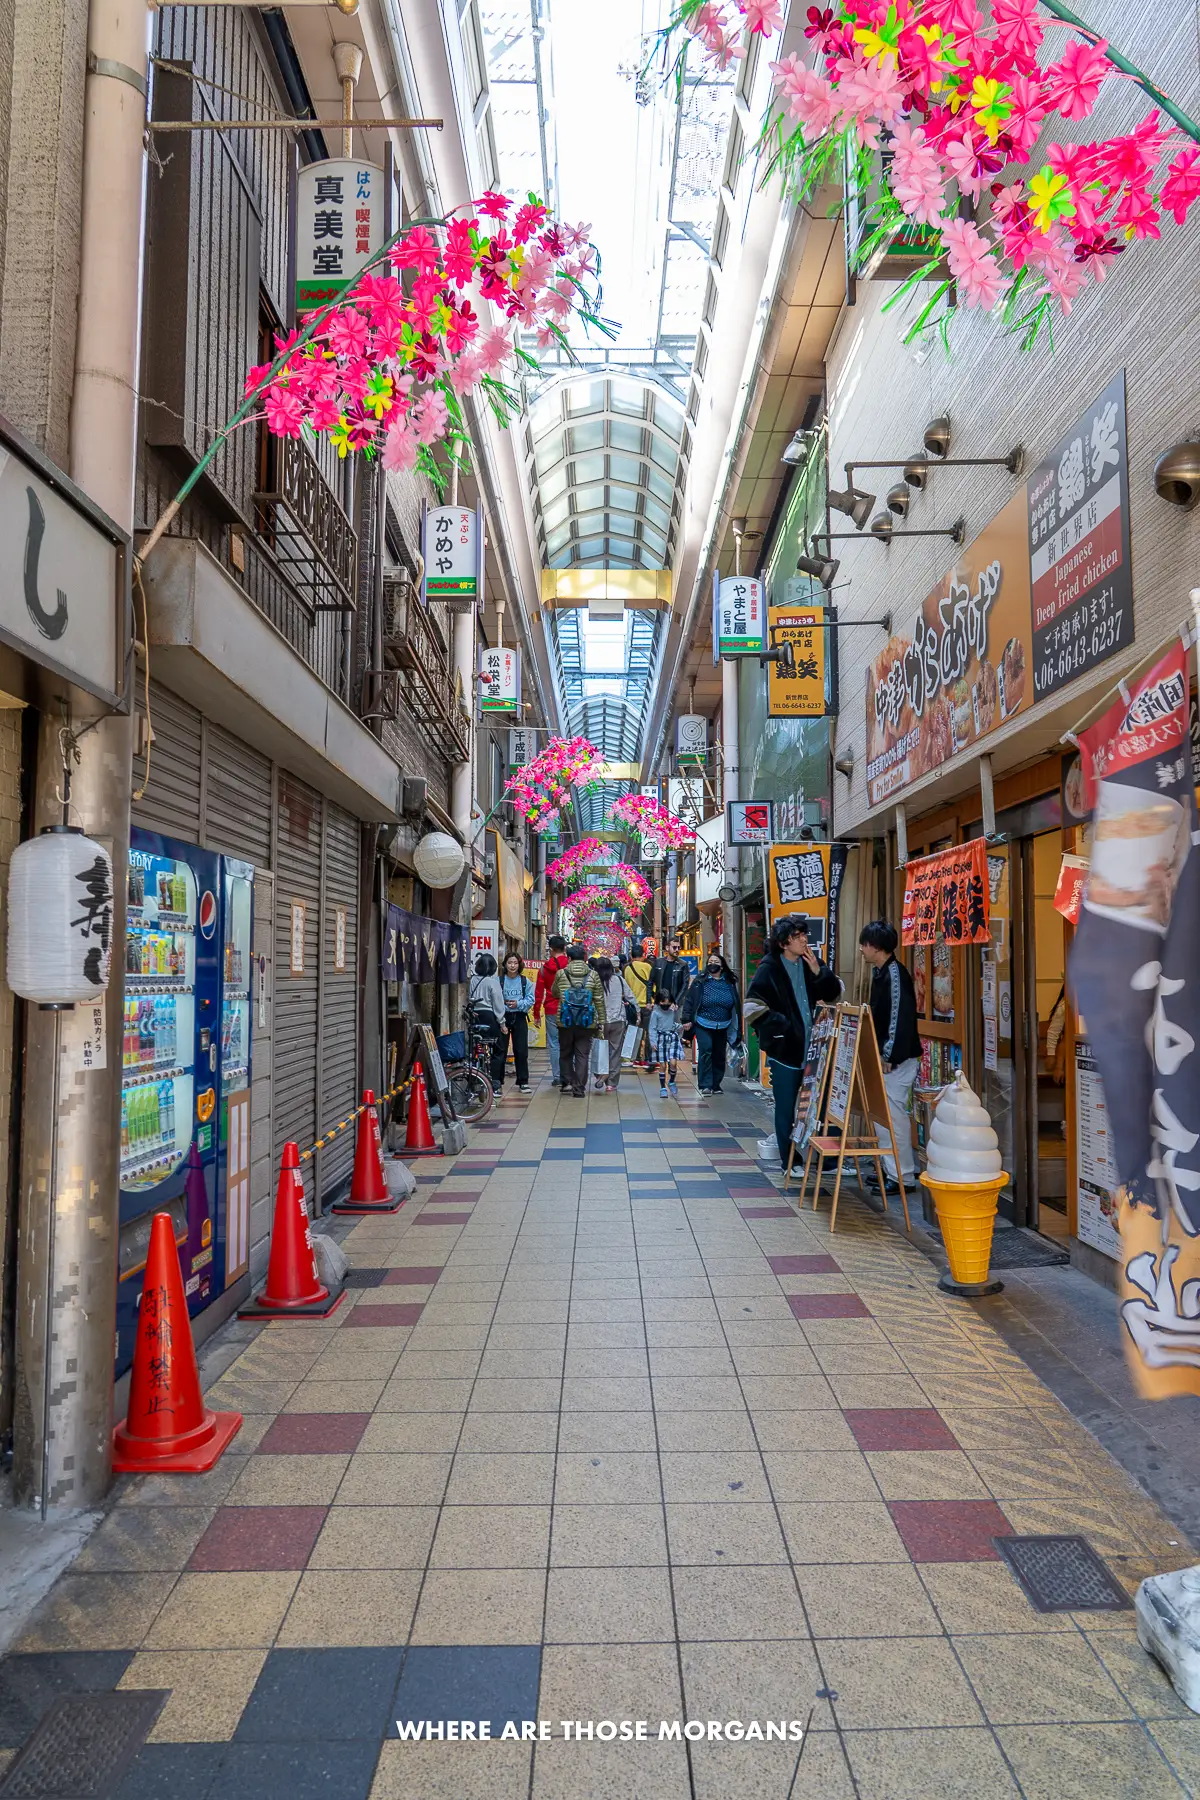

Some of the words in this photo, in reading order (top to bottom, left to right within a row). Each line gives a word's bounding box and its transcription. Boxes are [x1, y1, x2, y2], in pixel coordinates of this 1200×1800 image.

[313, 175, 344, 275] 真美堂
[356, 171, 371, 254] はん・喫煙具
[435, 516, 453, 574] かめや
[460, 513, 469, 544] 天ぷら
[1048, 501, 1097, 565] 新世界店
[1036, 601, 1056, 626] Deep
[1058, 575, 1080, 608] fried
[1083, 549, 1119, 588] chicken
[1055, 541, 1093, 588] Japanese
[724, 610, 732, 635] 2号店
[733, 584, 747, 635] やまと屋
[1041, 609, 1124, 689] 06-6643-6237
[488, 655, 500, 696] 松栄堂
[515, 731, 526, 763] 千成屋
[775, 856, 803, 903] 満足
[799, 853, 826, 898] 満腹
[470, 935, 491, 950] PEN
[83, 1040, 93, 1067] 作動中
[93, 1008, 102, 1053] 防犯カメラ
